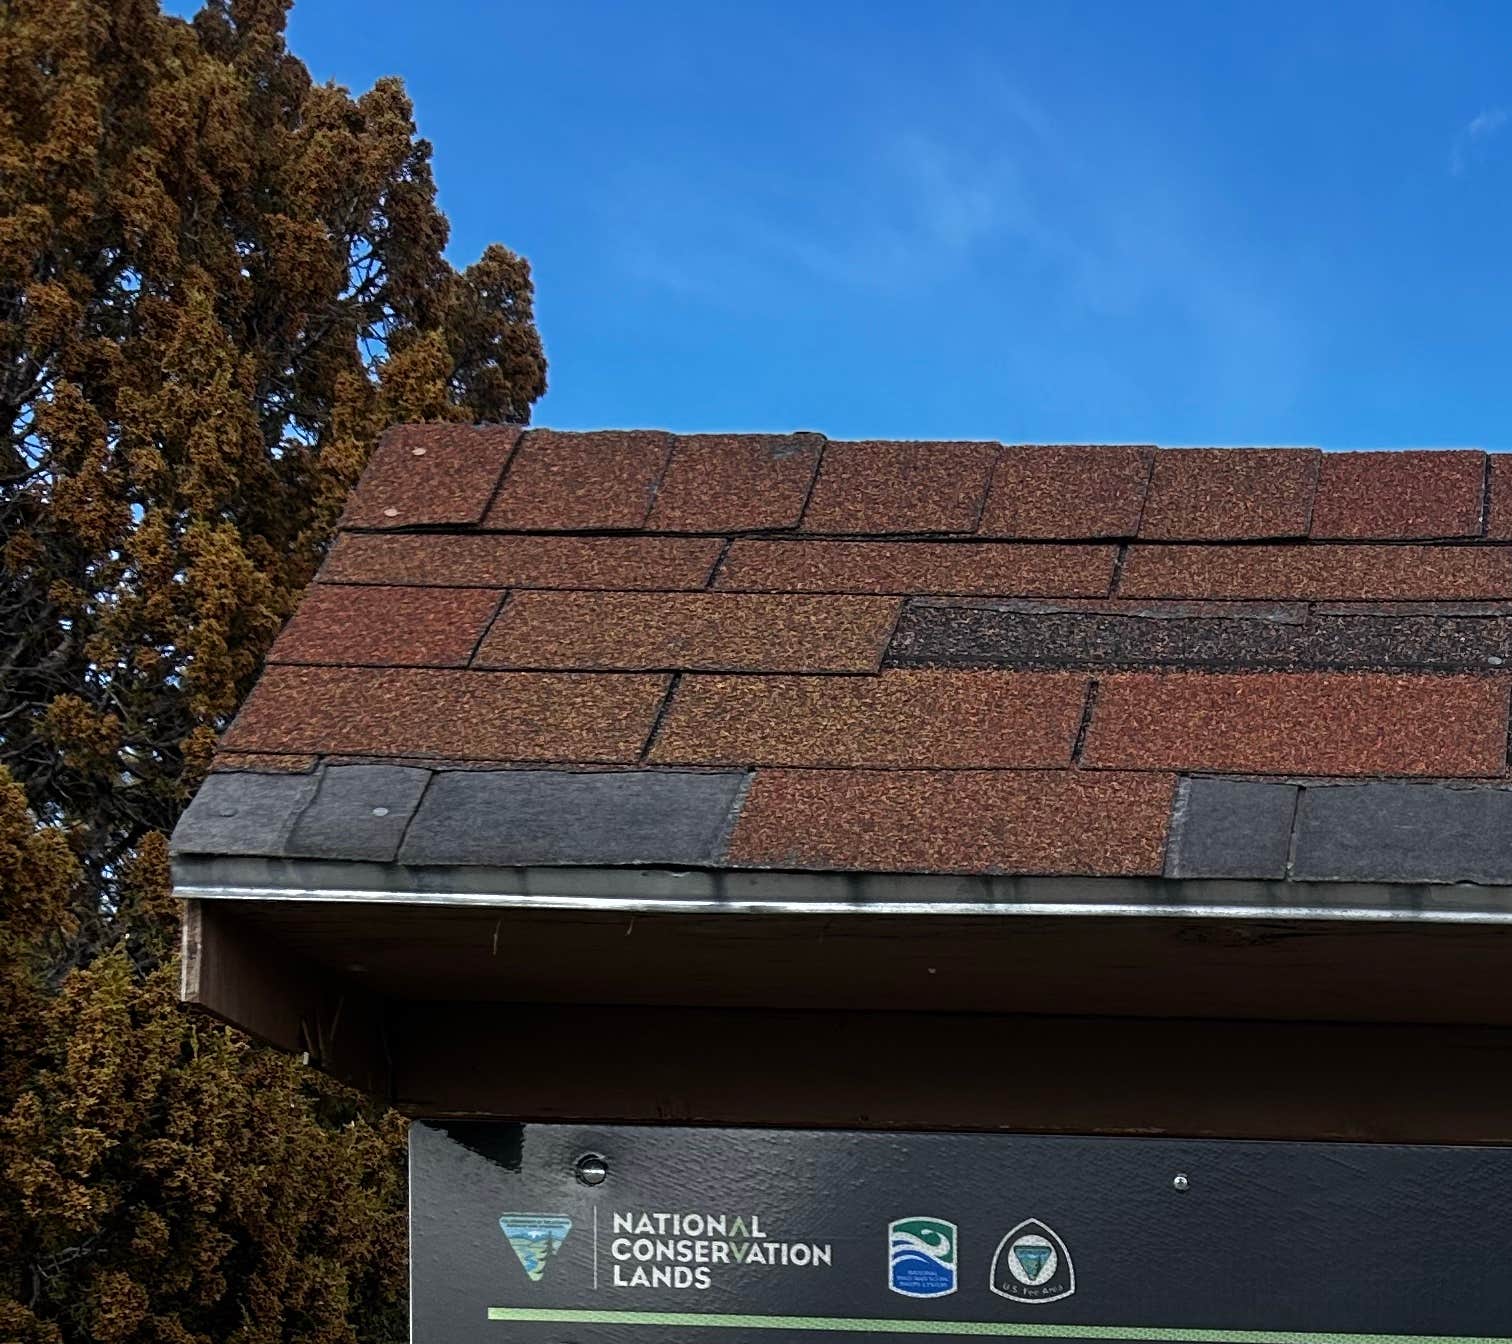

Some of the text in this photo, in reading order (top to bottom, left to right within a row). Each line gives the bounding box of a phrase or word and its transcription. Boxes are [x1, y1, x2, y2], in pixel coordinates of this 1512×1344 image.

[613, 1212, 766, 1237] NATIONAL
[611, 1238, 831, 1266] CONSERVATION
[614, 1265, 711, 1289] LANDS
